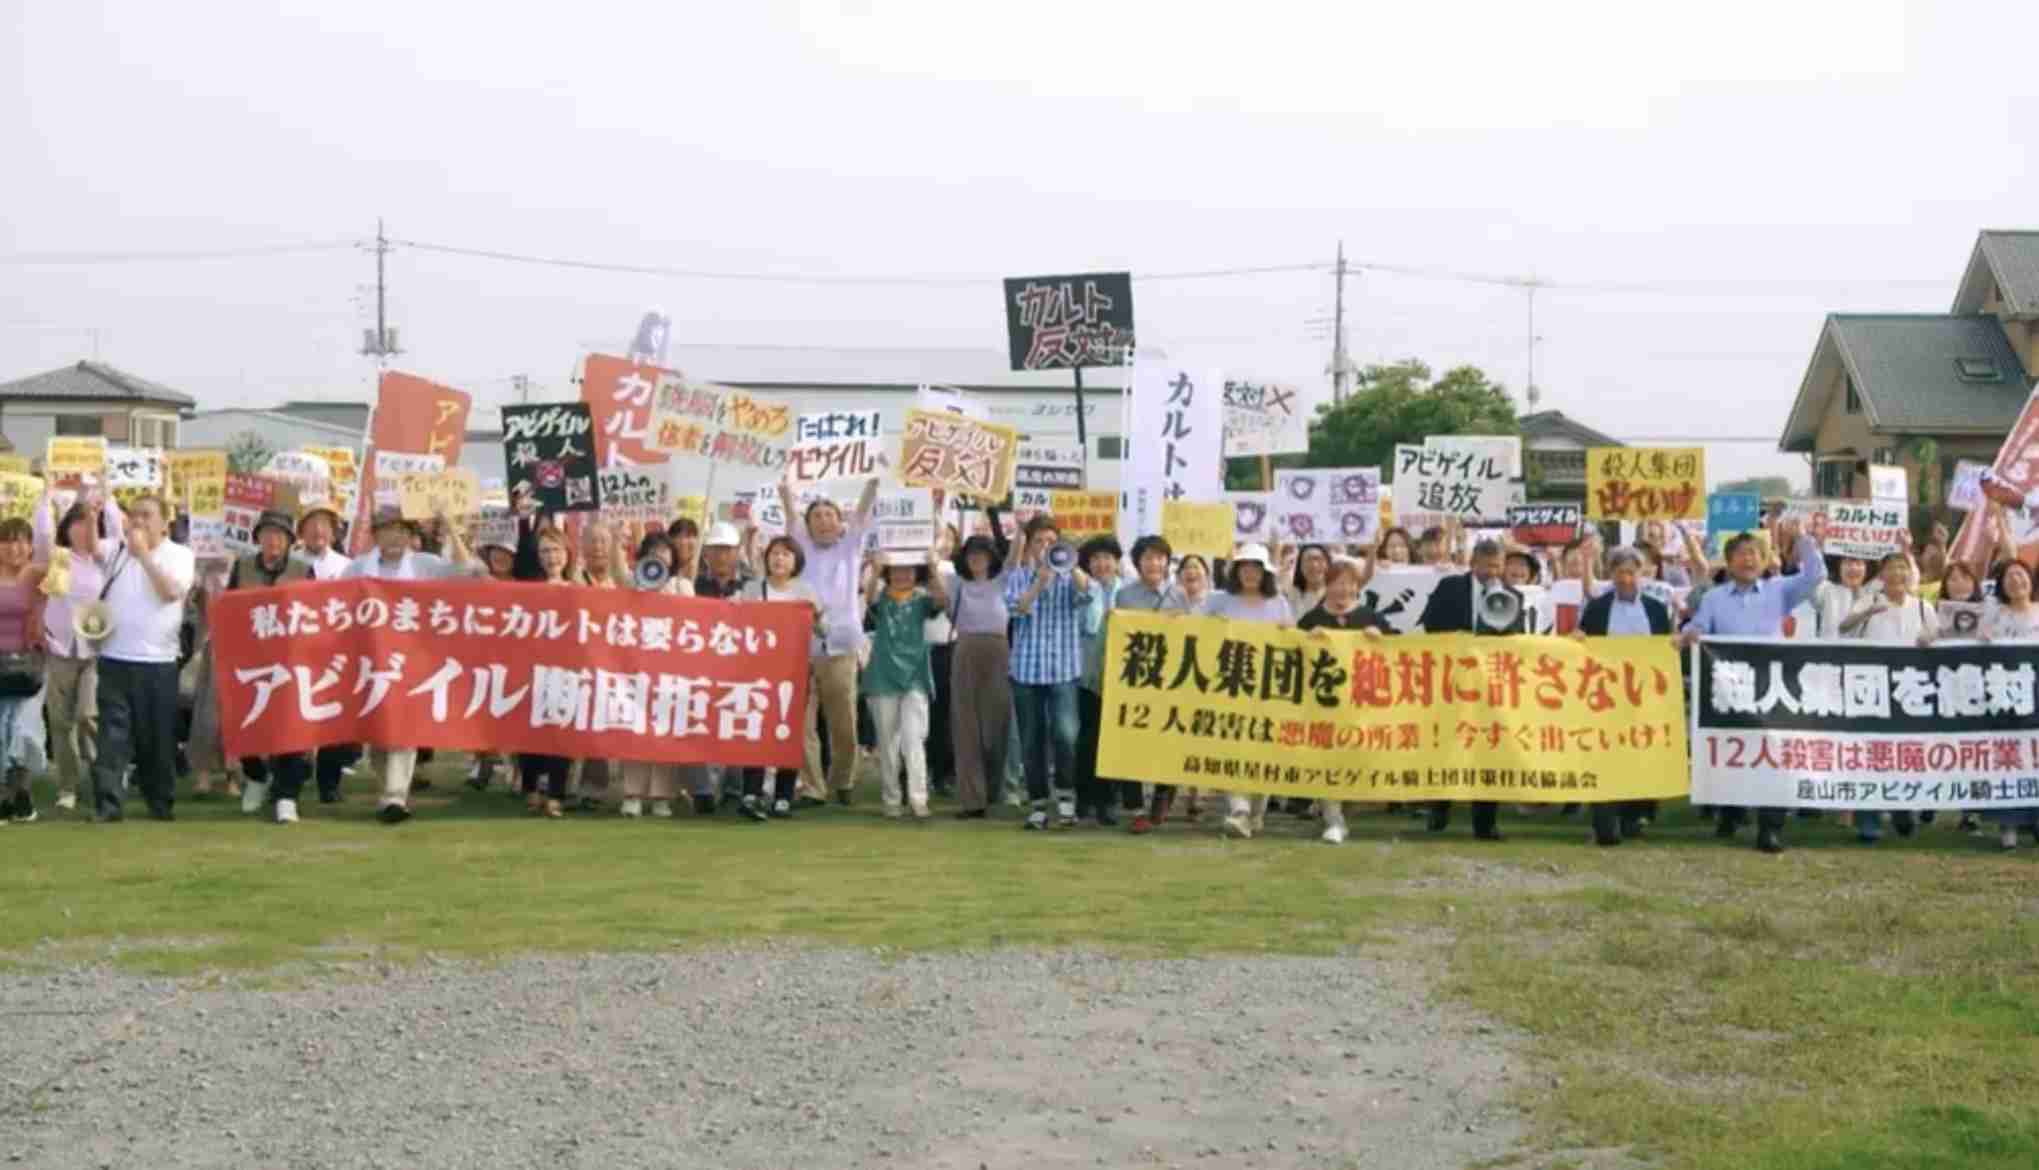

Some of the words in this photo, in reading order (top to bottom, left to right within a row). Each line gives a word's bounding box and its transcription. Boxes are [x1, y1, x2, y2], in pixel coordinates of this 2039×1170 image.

[503, 406, 591, 441] アビゲイル
[604, 372, 653, 468] カルト
[1400, 449, 1503, 480] アビゲイル
[1602, 450, 1697, 479] 殺人集団
[1418, 481, 1483, 515] 追放
[1835, 508, 1899, 525] カルトは
[252, 597, 777, 655] 私たちのまちにカルトは要らない
[1120, 631, 1668, 712] 殺人集団を絶対に許さない
[1711, 659, 2037, 718] 殺人集団を絶対
[234, 652, 793, 740] アビゲイル断固拒否！
